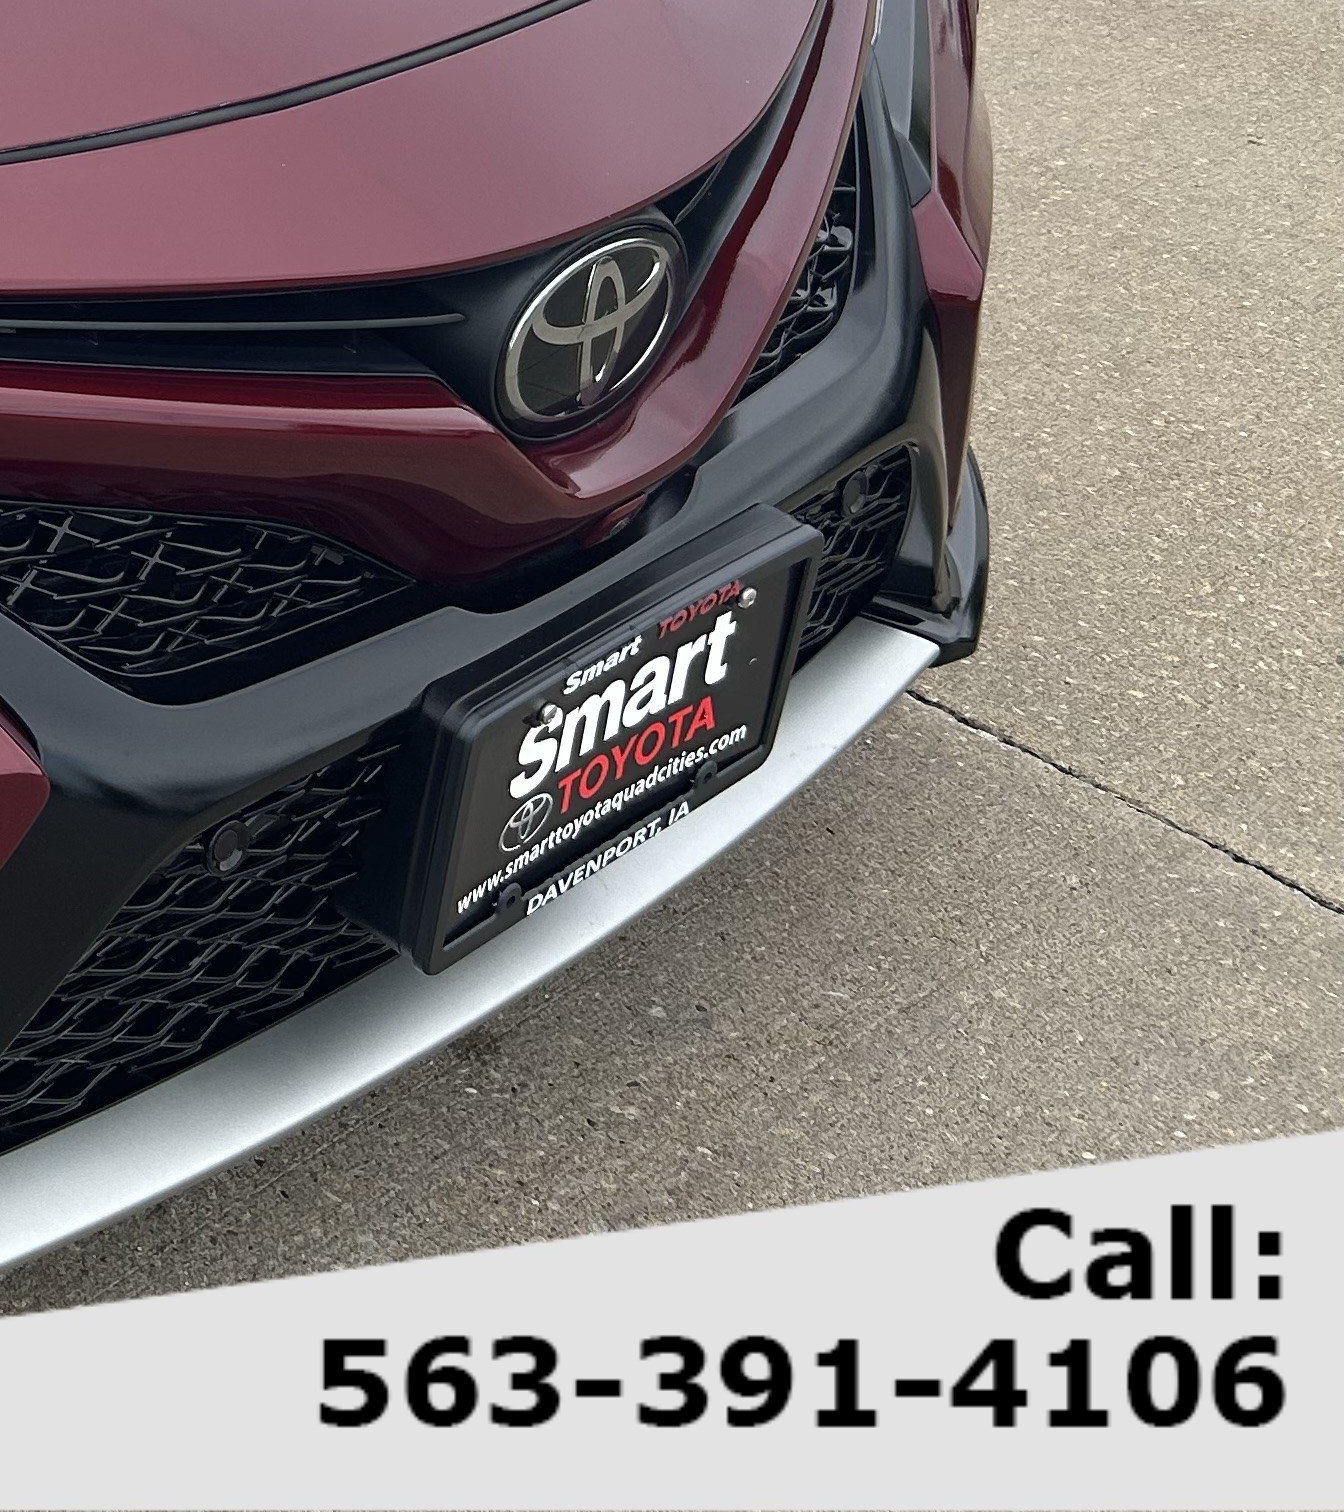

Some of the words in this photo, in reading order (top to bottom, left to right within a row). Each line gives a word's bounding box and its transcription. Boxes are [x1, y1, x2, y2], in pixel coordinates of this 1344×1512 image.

[562, 634, 643, 695] Smart
[657, 578, 744, 639] TOYOTA
[556, 695, 716, 814] TOYOTA
[456, 724, 748, 915] www.smarttoyotaquadcities.com
[526, 820, 662, 916] DAVENPORT,
[667, 800, 691, 826] IA
